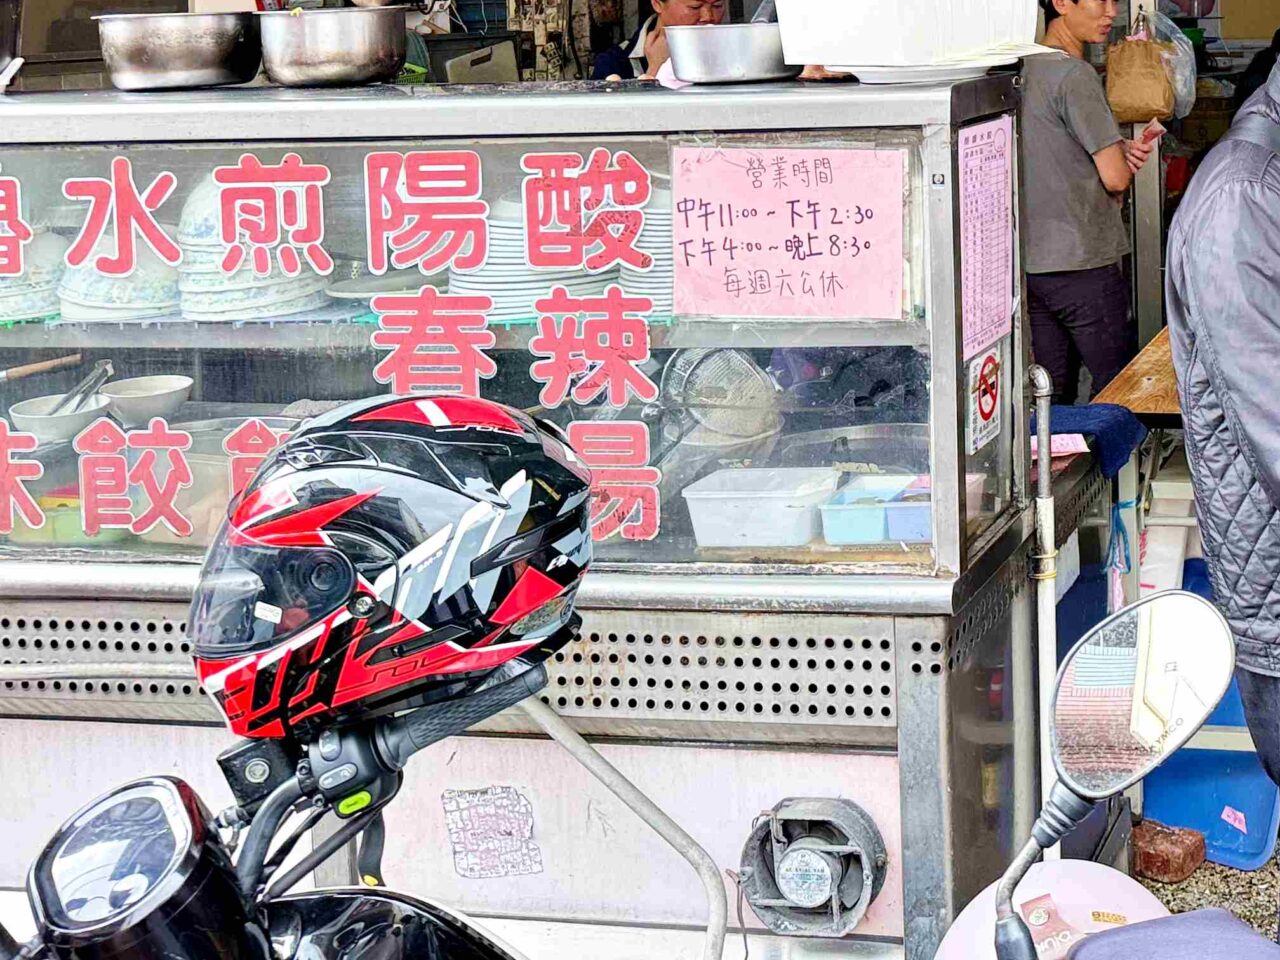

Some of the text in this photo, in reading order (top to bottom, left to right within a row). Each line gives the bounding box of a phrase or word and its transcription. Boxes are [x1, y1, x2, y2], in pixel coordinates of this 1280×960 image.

[745, 157, 833, 190] 營業時間
[722, 267, 844, 298] 每週六公休
